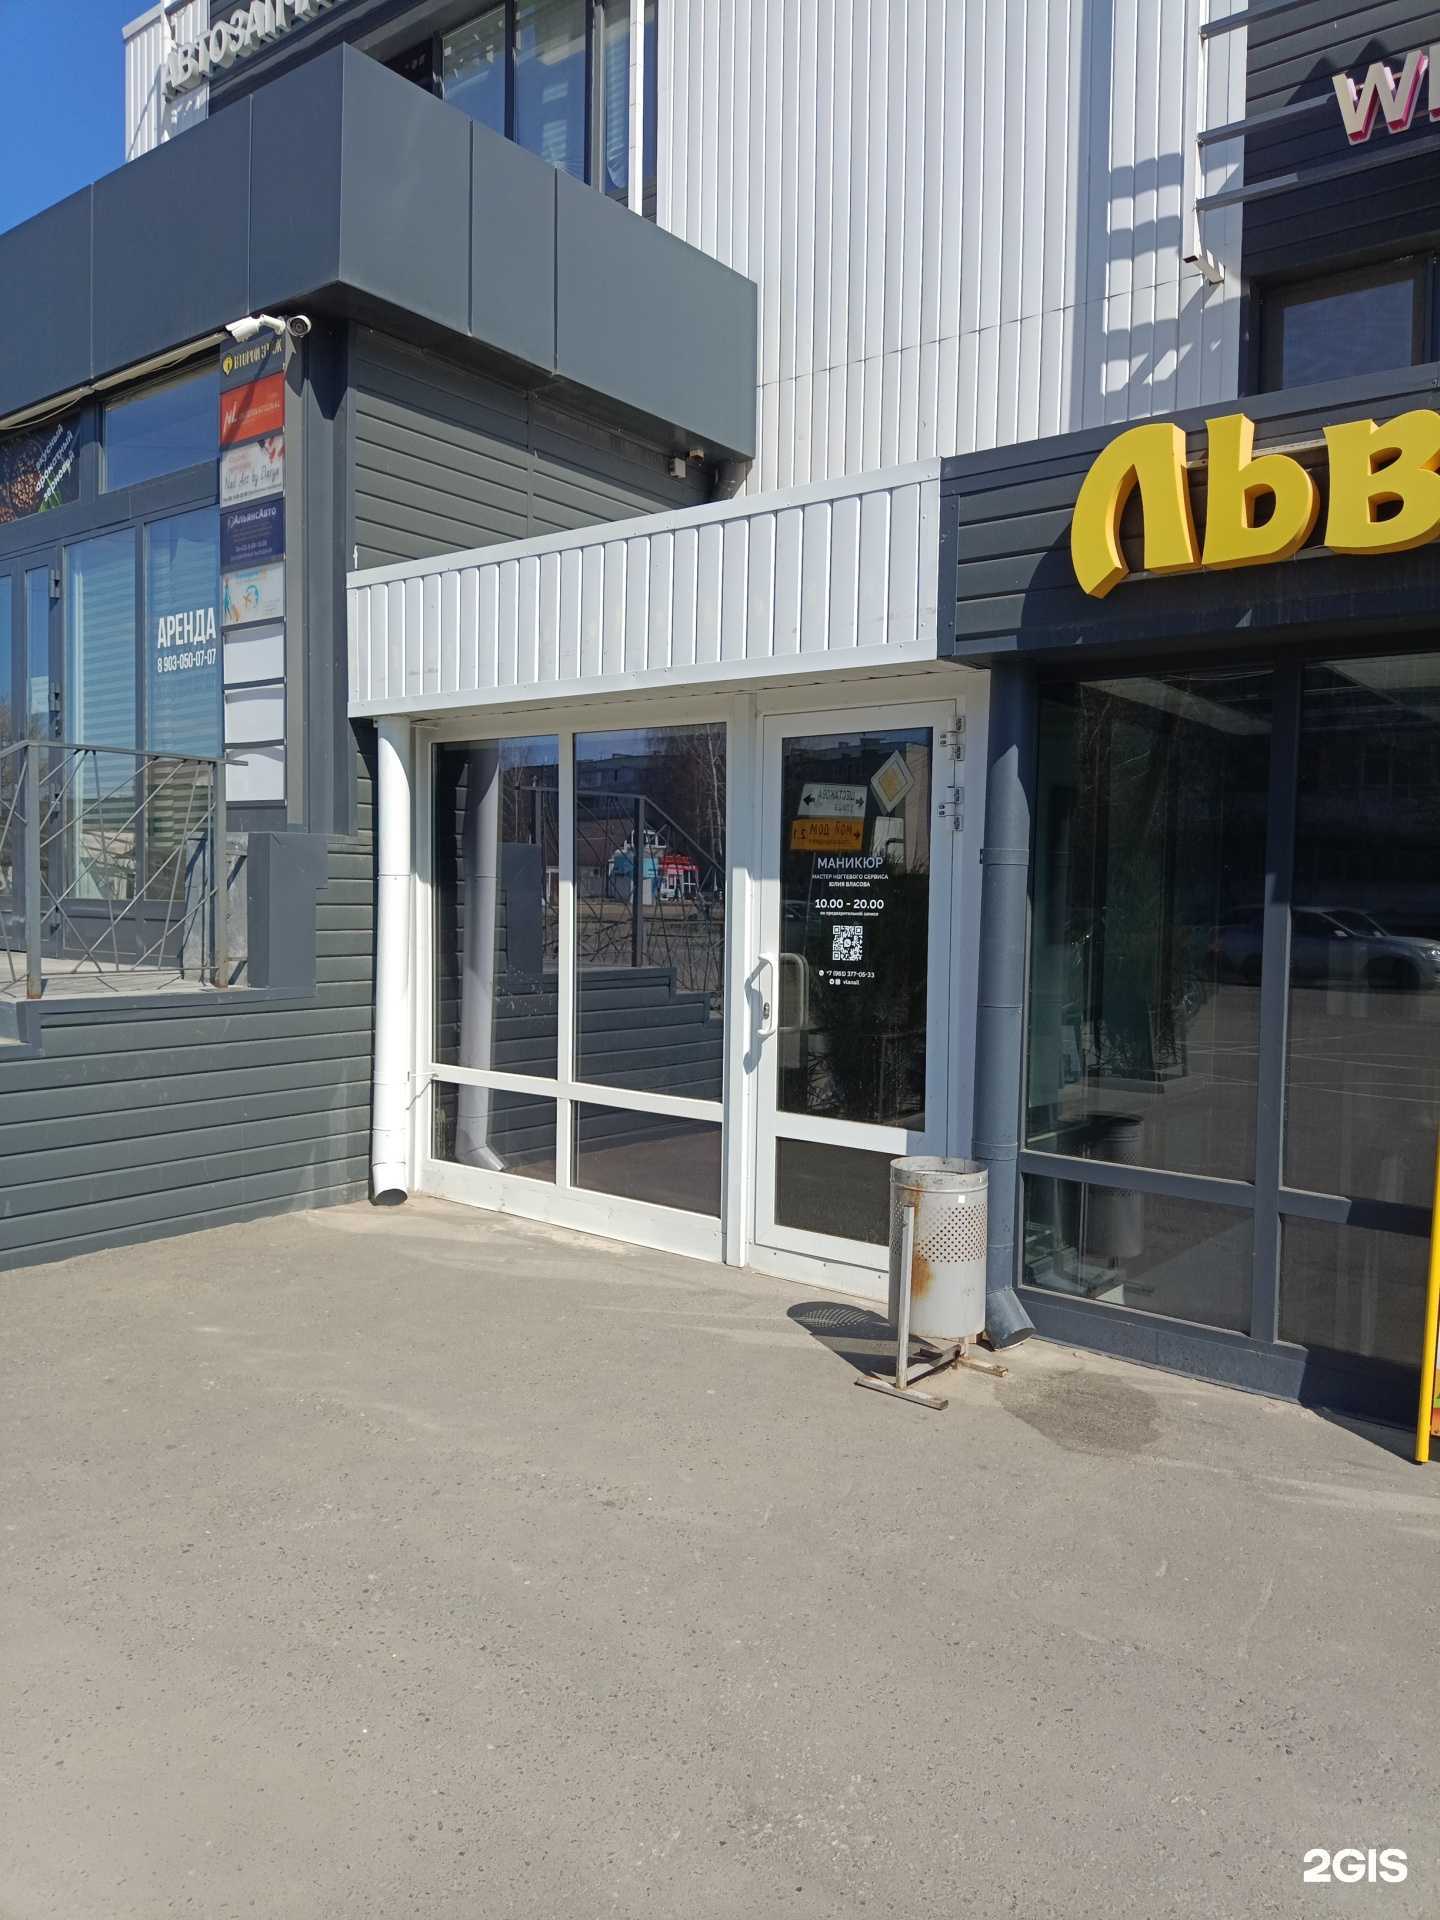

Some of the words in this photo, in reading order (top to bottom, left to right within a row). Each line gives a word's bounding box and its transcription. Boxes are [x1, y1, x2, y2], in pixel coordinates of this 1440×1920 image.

[157, 607, 217, 649] АРЕНДА
[157, 657, 163, 673] 8
[163, 648, 217, 673] 903-050-07-07
[817, 856, 884, 869] МАНИКЮР
[815, 898, 844, 909] 10.00
[853, 899, 885, 910] 20.00
